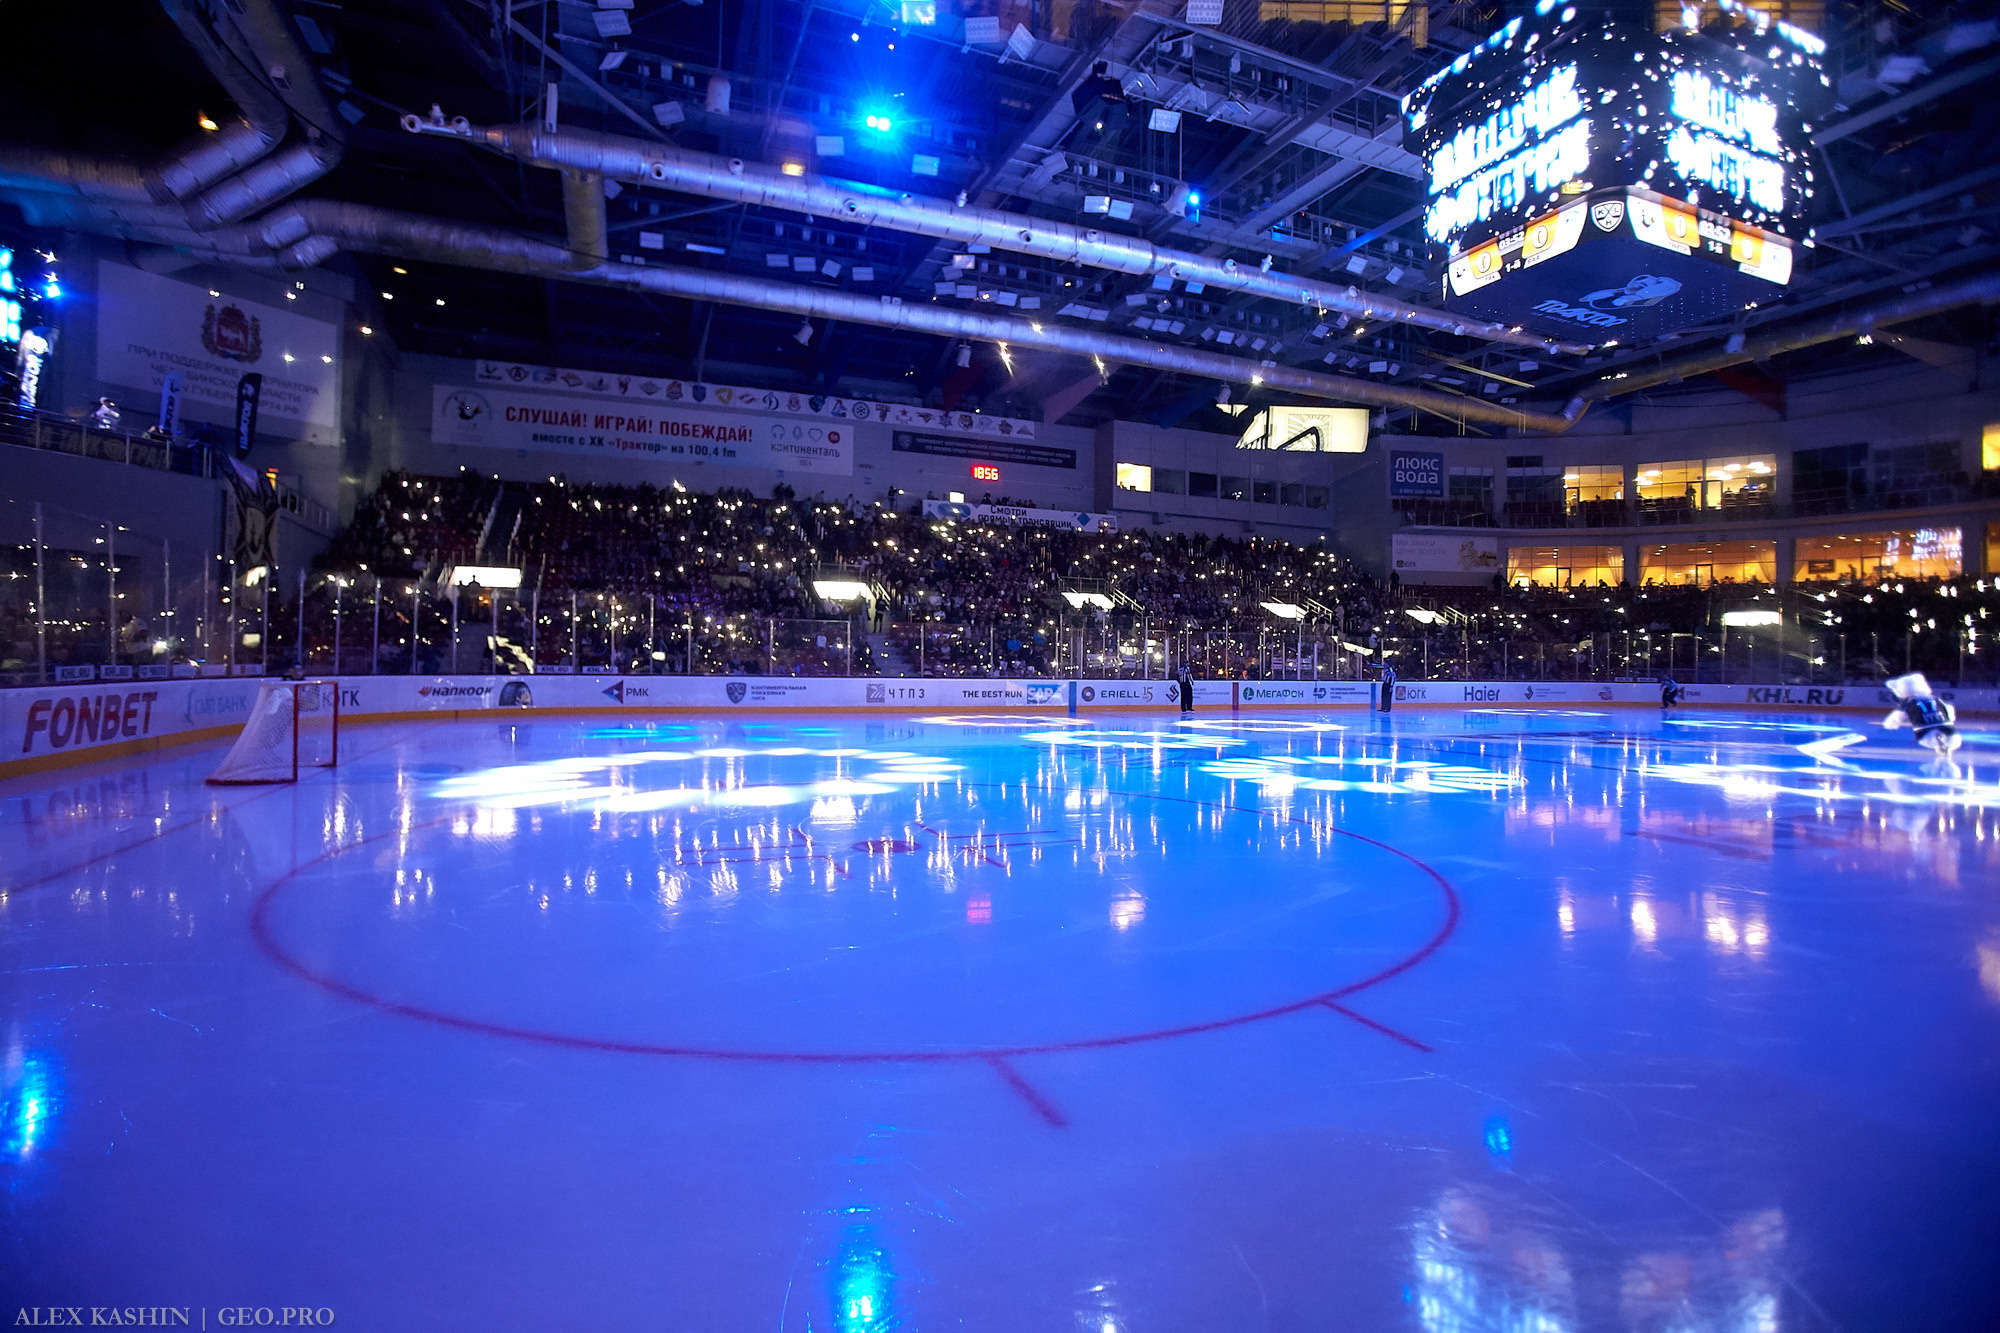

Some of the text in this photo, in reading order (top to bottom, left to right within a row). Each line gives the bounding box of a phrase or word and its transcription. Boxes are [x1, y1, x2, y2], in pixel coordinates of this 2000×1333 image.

[1674, 214, 1687, 238] 0
[1499, 230, 1525, 250] 03:52
[1532, 225, 1549, 249] 0
[1741, 237, 1754, 260] 0
[1477, 251, 1492, 274] 0
[128, 344, 157, 362] ПРИ
[160, 352, 238, 379] ПОДДЕРЖКЕ
[506, 406, 753, 444] СЛУШАЙ! ИГРАЙ! ПОБЕЖДАЙ!
[532, 433, 574, 445] вместе
[578, 436, 586, 446] с
[589, 435, 605, 447] ХК
[671, 444, 685, 454] на
[722, 446, 737, 458] fm
[770, 442, 841, 459] континенталь
[990, 504, 1028, 517] Смотри
[1018, 517, 1073, 529] трансляции
[962, 690, 1022, 698] THE BEST RUN
[1027, 687, 1054, 702] SAP
[1101, 690, 1140, 699] ERIELL
[1407, 688, 1427, 700] ЮГК
[1464, 686, 1500, 701] Haier
[1746, 687, 1845, 705] KHL.RU
[217, 696, 247, 713] БАНК
[22, 691, 158, 753] FONBET
